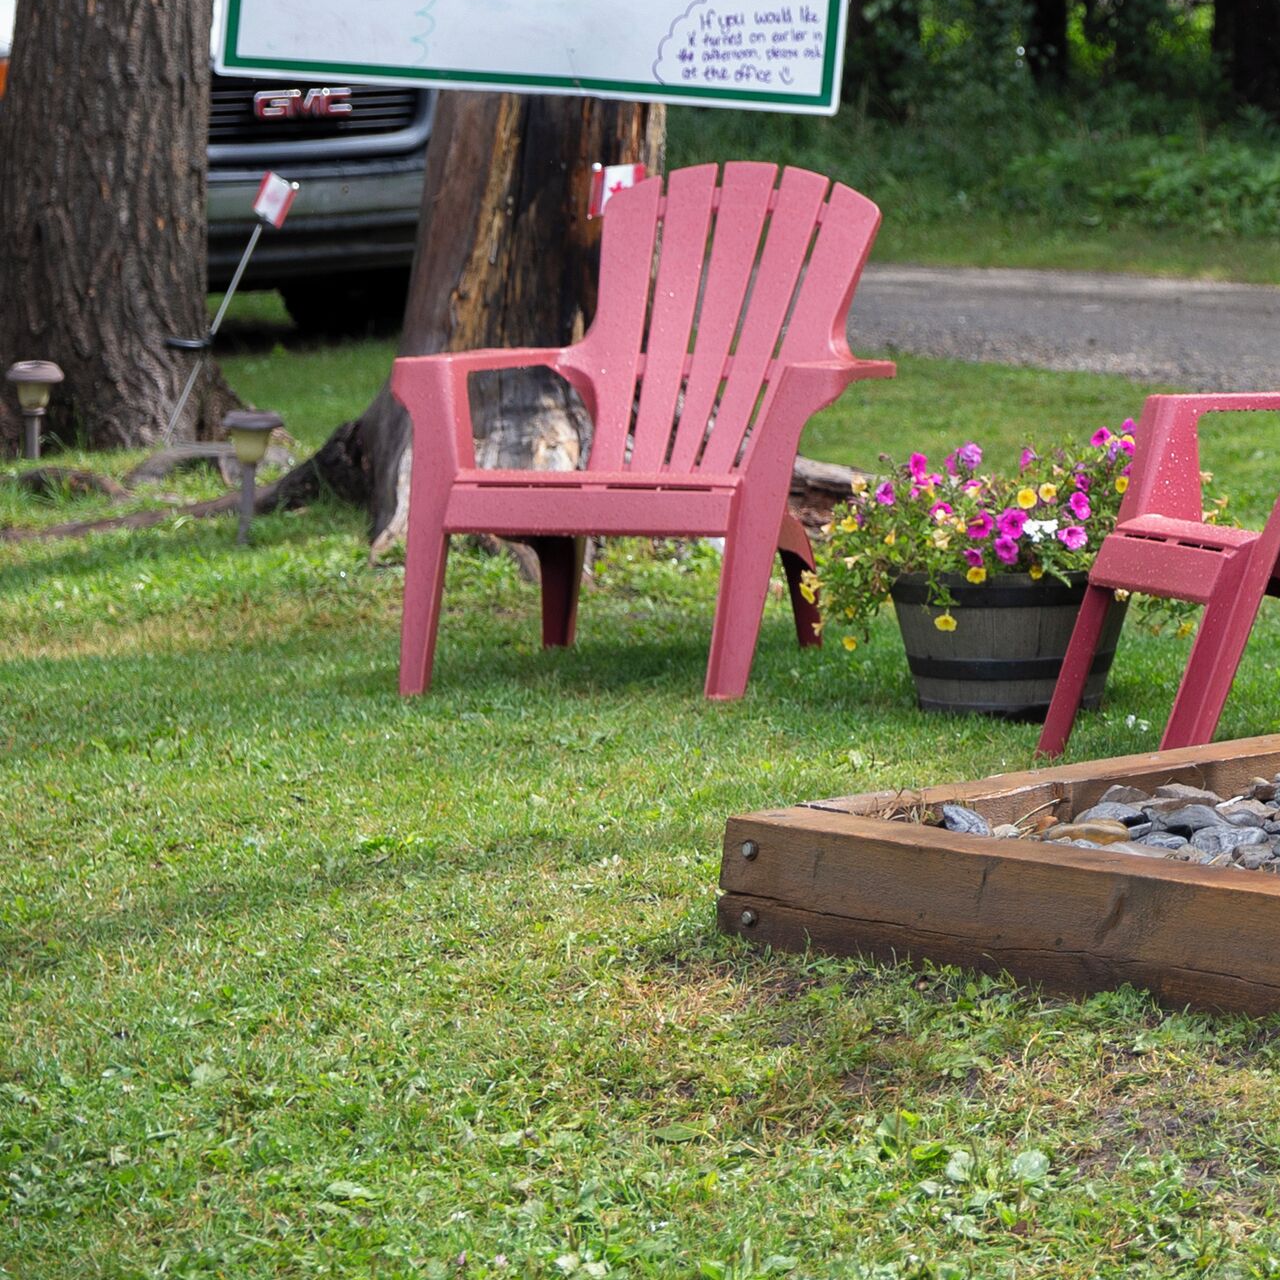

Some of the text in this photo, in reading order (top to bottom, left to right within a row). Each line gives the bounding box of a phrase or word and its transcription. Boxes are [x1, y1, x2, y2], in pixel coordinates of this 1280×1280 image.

[718, 14, 745, 35] you
[754, 5, 792, 25] would
[254, 87, 352, 121] GMC
